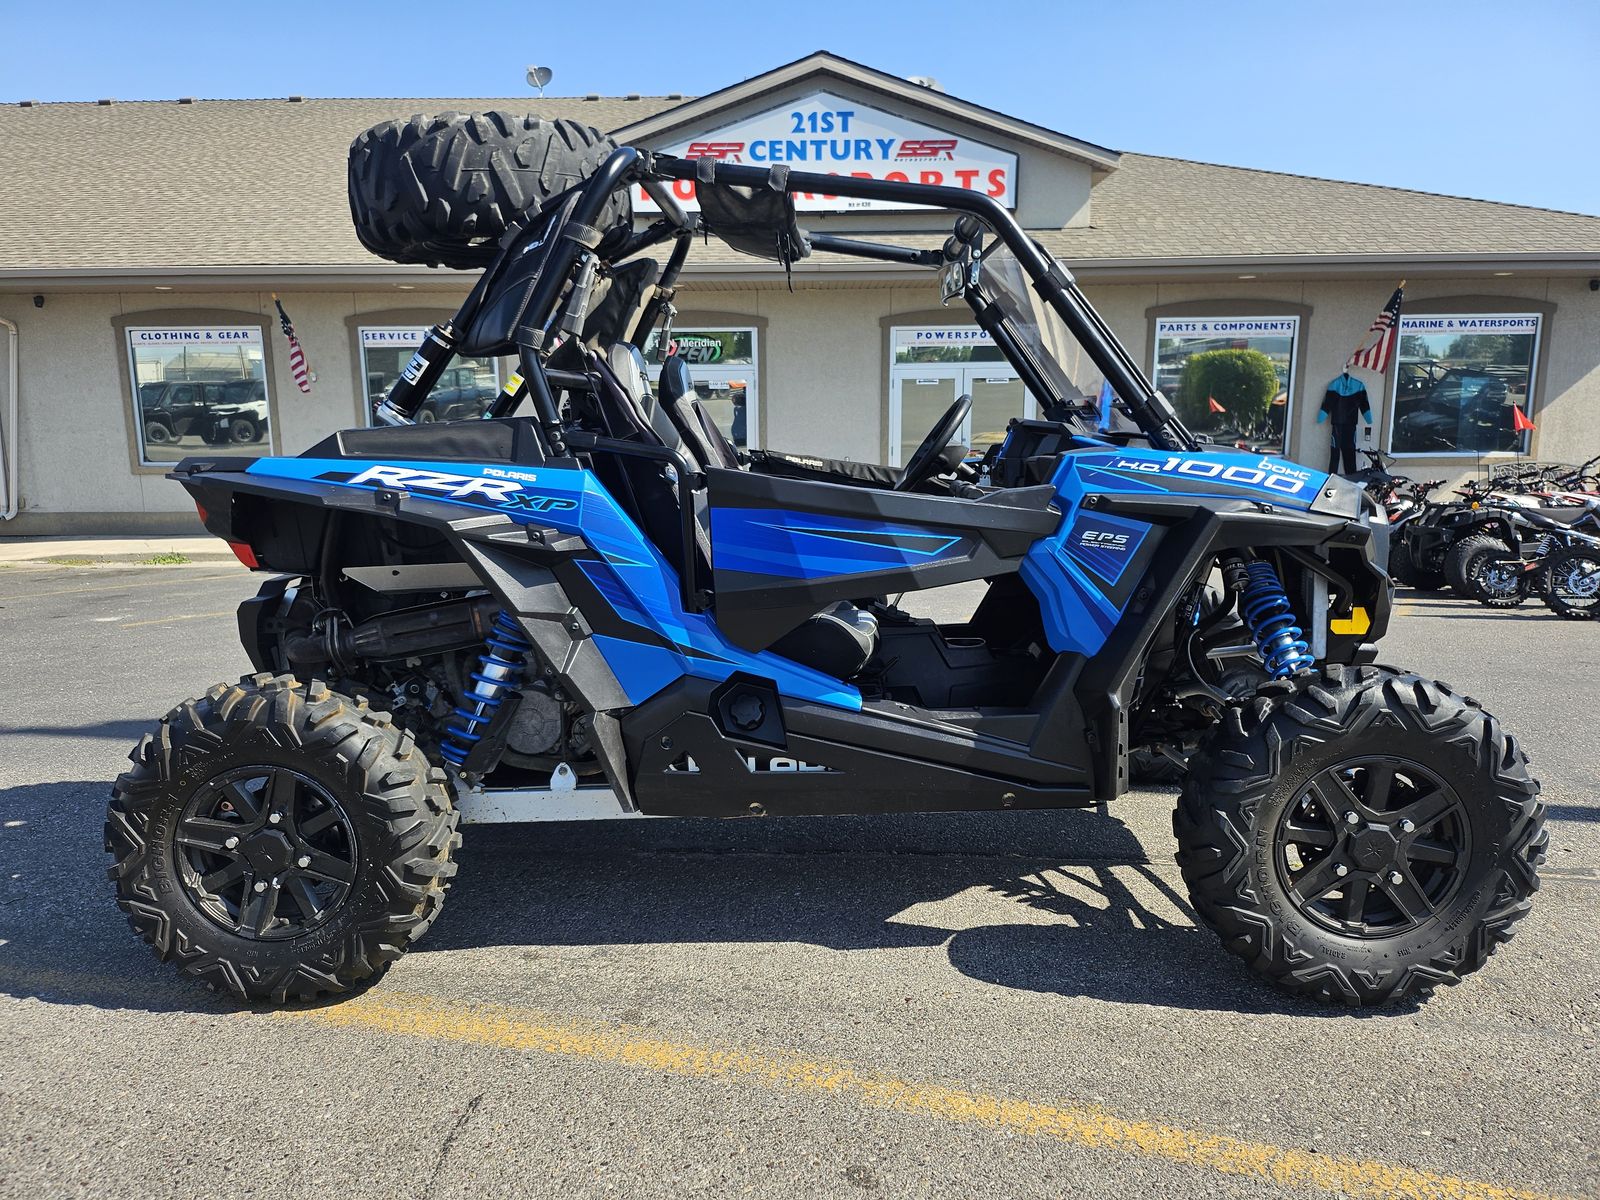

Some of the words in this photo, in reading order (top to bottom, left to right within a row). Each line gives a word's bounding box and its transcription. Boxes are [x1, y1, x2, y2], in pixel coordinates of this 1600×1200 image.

[791, 111, 855, 133] 21ST
[685, 142, 745, 163] SSR
[749, 138, 897, 161] CENTURY
[895, 139, 958, 161] SSR
[1160, 323, 1197, 332] PARTS
[1201, 323, 1208, 331] &
[1213, 322, 1292, 331] COMPONENTS
[1401, 320, 1444, 329] MARINE
[1447, 320, 1454, 328] &
[1458, 319, 1537, 328] WATERSPORTS
[140, 331, 200, 340] CLOTHING
[205, 331, 213, 339] &
[218, 331, 249, 339] GEAR
[364, 332, 417, 340] SERVICE
[680, 338, 722, 347] Meridian
[916, 331, 993, 340] POWERSPO
[785, 455, 823, 467] POLARIS
[483, 467, 537, 482] POLARIS
[1162, 457, 1305, 494] 1000
[1257, 461, 1312, 481] DOHC
[348, 465, 524, 502] RZR
[503, 493, 580, 512] XP
[1081, 530, 1130, 544] EPS
